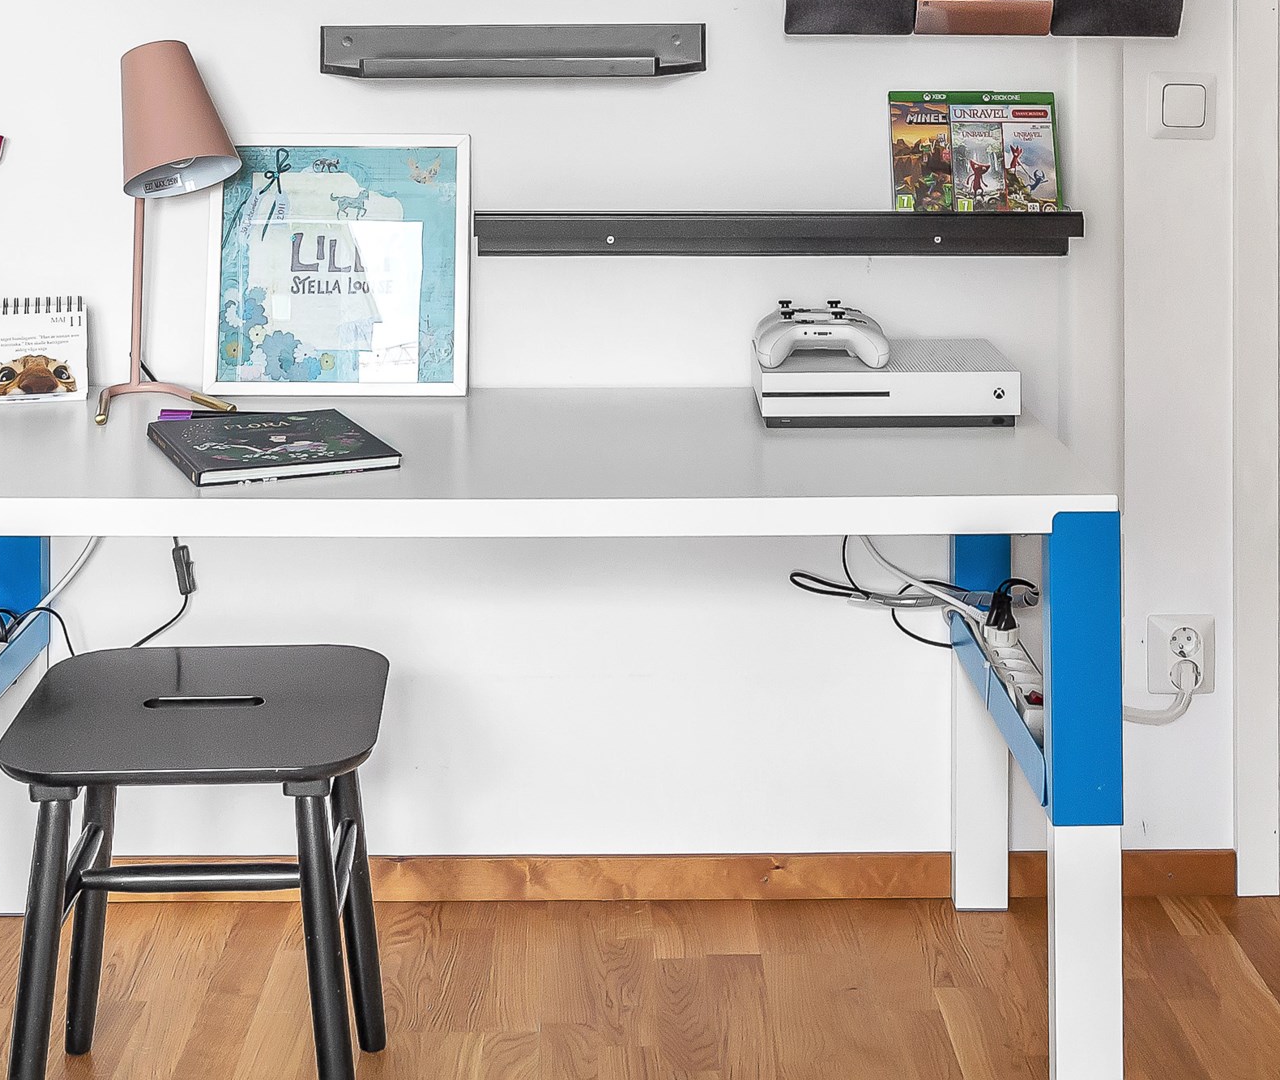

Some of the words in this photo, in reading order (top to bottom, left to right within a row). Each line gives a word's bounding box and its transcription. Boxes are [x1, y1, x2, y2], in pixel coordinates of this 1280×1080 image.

[906, 113, 947, 125] MINEC
[953, 108, 1008, 119] UNRAVEL
[290, 275, 341, 294] STELLA
